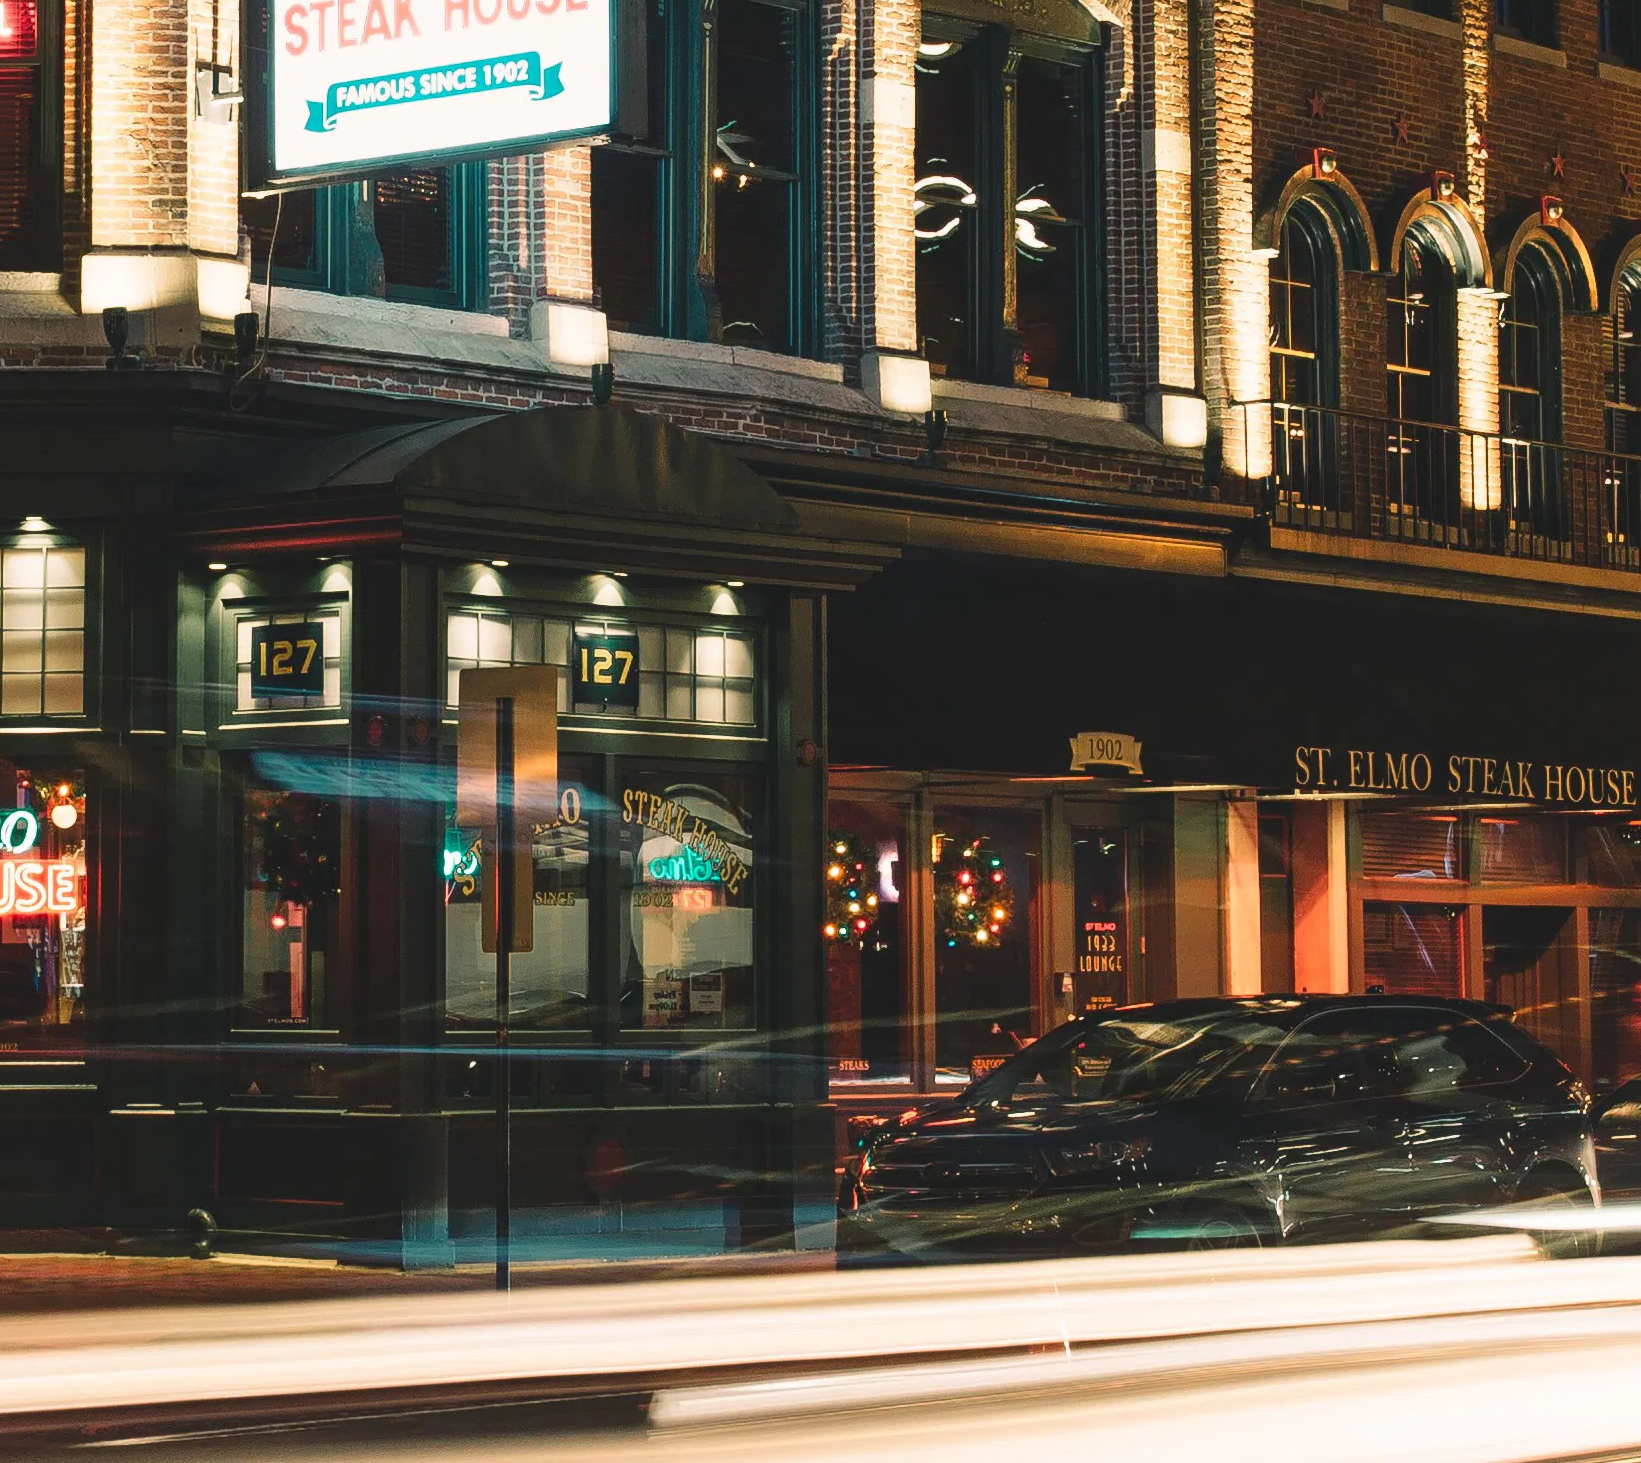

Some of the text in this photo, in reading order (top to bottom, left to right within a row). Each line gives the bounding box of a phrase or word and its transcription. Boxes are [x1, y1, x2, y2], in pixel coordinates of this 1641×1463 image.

[336, 58, 530, 109] FAMOUS SINCE 1902
[259, 639, 318, 676] 127
[580, 647, 635, 685] 127
[1088, 738, 1123, 761] 1902
[1295, 745, 1638, 806] ST. ELMO STEAK HOUSE
[622, 788, 691, 843] STEAK
[688, 817, 749, 896] HOUSE
[535, 891, 576, 907] SINCE
[1087, 934, 1116, 952] 1933
[1080, 955, 1123, 972] LOUNGE
[838, 1059, 870, 1071] STEAKS
